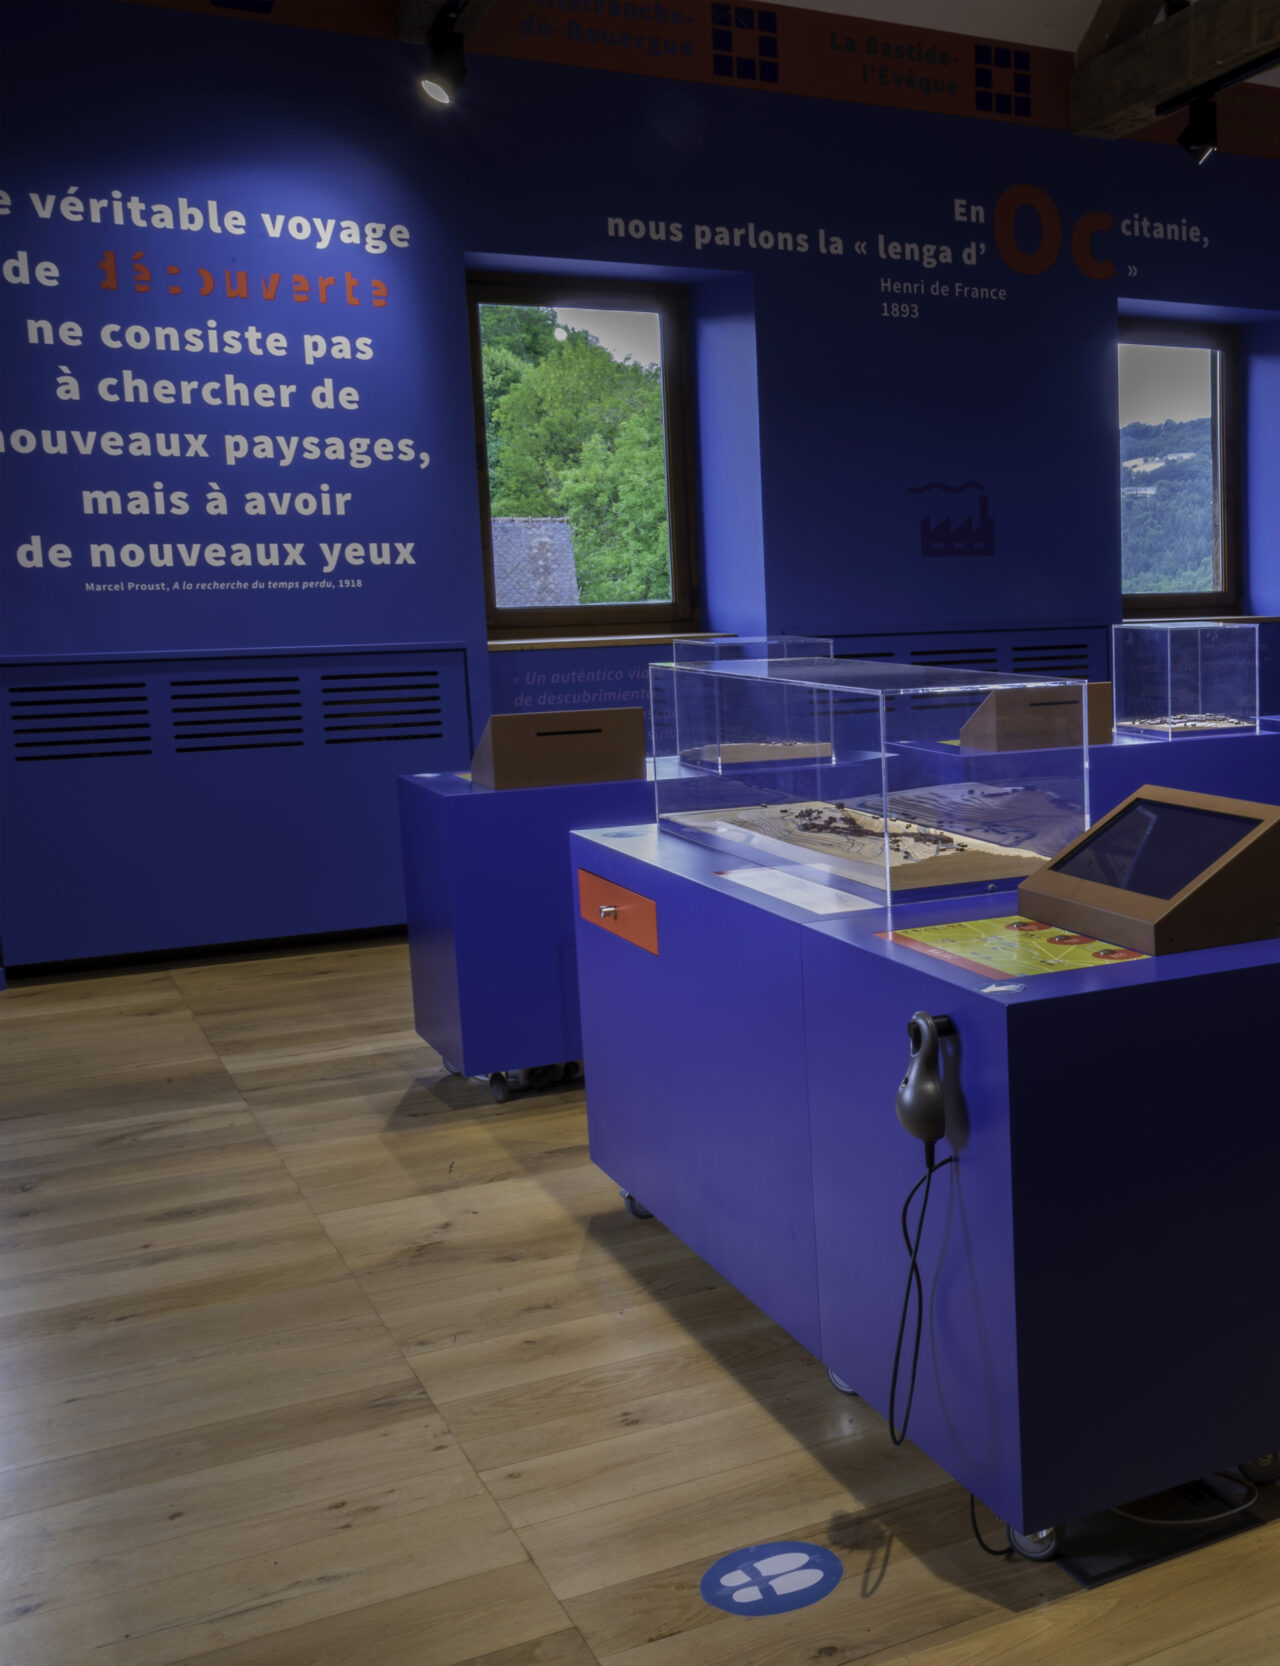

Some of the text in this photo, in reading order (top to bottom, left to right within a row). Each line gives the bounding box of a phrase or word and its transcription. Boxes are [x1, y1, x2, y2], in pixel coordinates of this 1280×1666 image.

[830, 31, 960, 67] La Bastide-
[29, 186, 247, 236] véritable
[260, 212, 410, 255] voyage
[953, 198, 985, 224] En
[1120, 212, 1210, 249] citanie,
[607, 216, 684, 243] nous
[694, 222, 809, 253] parlons
[818, 228, 844, 256] la
[877, 233, 953, 269] lenga
[2, 250, 60, 287] de
[880, 277, 1007, 301] Henri de France
[881, 301, 920, 319] 1893
[26, 319, 374, 366] ne consiste pas
[55, 365, 360, 411] à chercher de
[0, 428, 430, 470] ouveaux paysages,
[81, 480, 353, 516] mais à avoir
[16, 534, 417, 574] de nouveaux yeux
[84, 578, 363, 592] Marcel Proust, A la recherche du temps perdu, 1918
[525, 671, 547, 686] Un
[551, 667, 624, 685] auténtico
[513, 687, 656, 708] de descubrimiento
